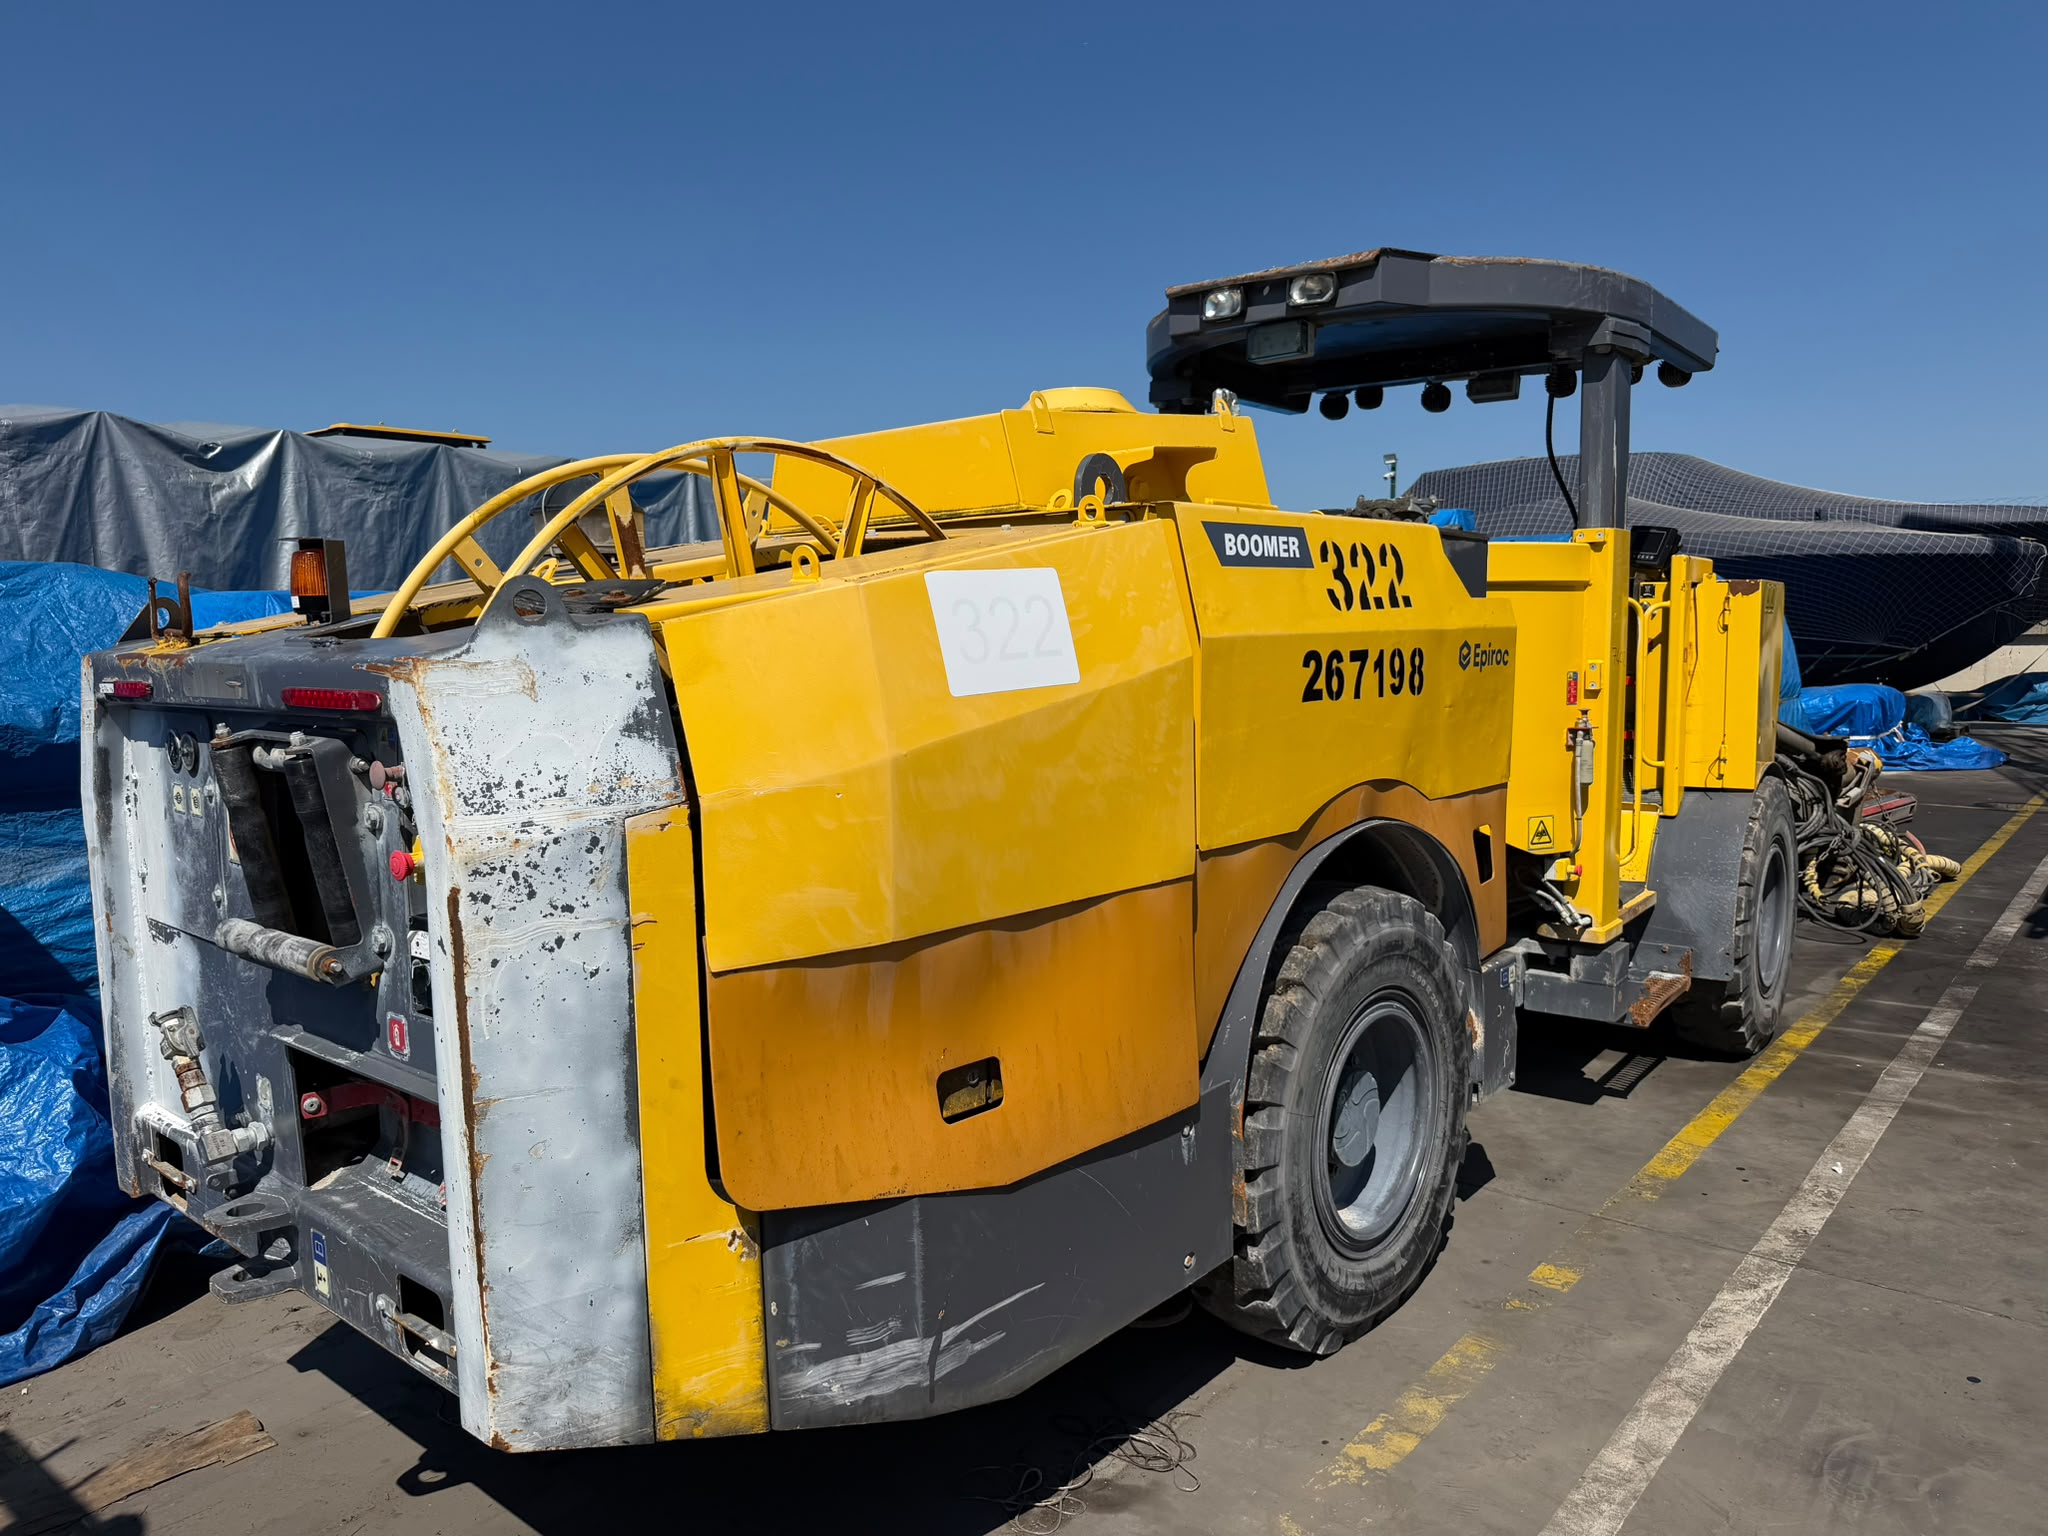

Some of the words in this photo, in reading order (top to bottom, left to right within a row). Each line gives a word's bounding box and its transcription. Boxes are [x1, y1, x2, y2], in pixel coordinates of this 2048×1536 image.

[1224, 533, 1300, 558] BOOMER
[1319, 540, 1413, 612] 322
[951, 593, 1064, 665] 322
[1473, 642, 1509, 672] Epiroc
[1301, 647, 1426, 703] 267198
